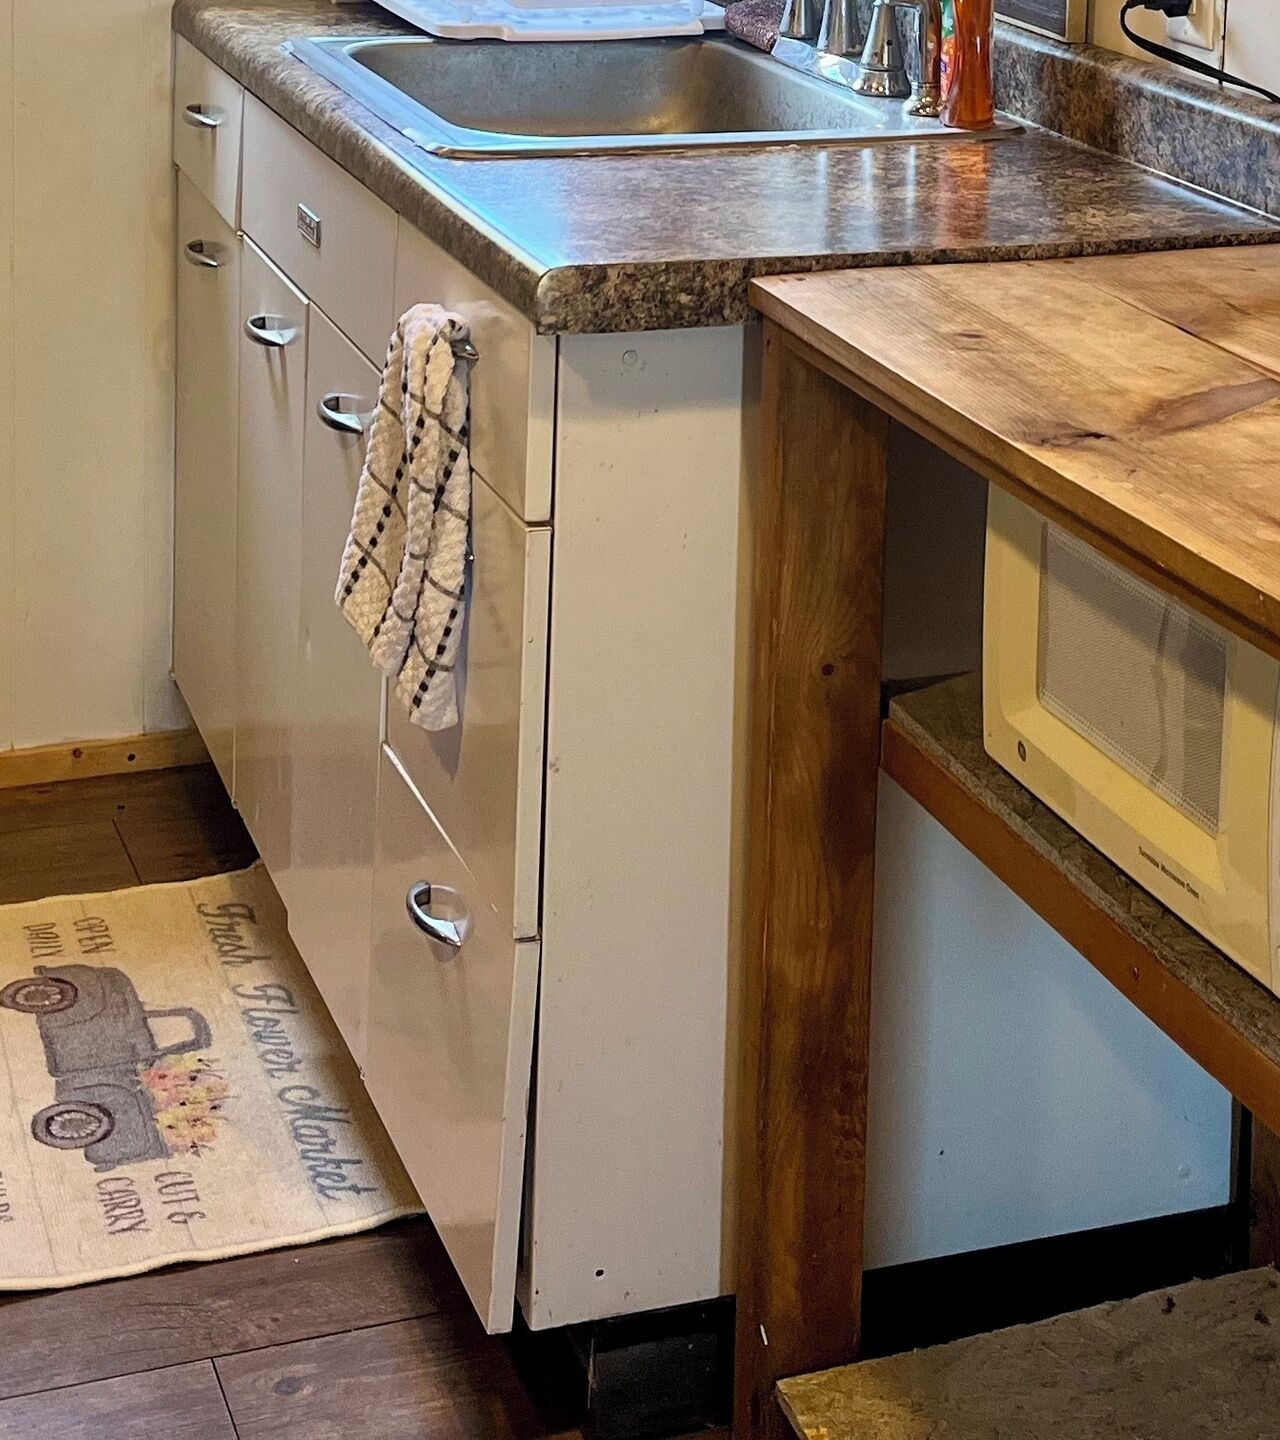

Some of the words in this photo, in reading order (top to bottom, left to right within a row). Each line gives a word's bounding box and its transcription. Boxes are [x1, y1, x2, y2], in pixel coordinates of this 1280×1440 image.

[23, 922, 65, 958] DAILY
[72, 915, 116, 955] OPEN
[196, 901, 272, 969] Fresh
[232, 980, 301, 1081] Flower
[276, 1083, 380, 1201] Market
[96, 1176, 152, 1236] CARRY
[154, 1170, 201, 1206] CUT
